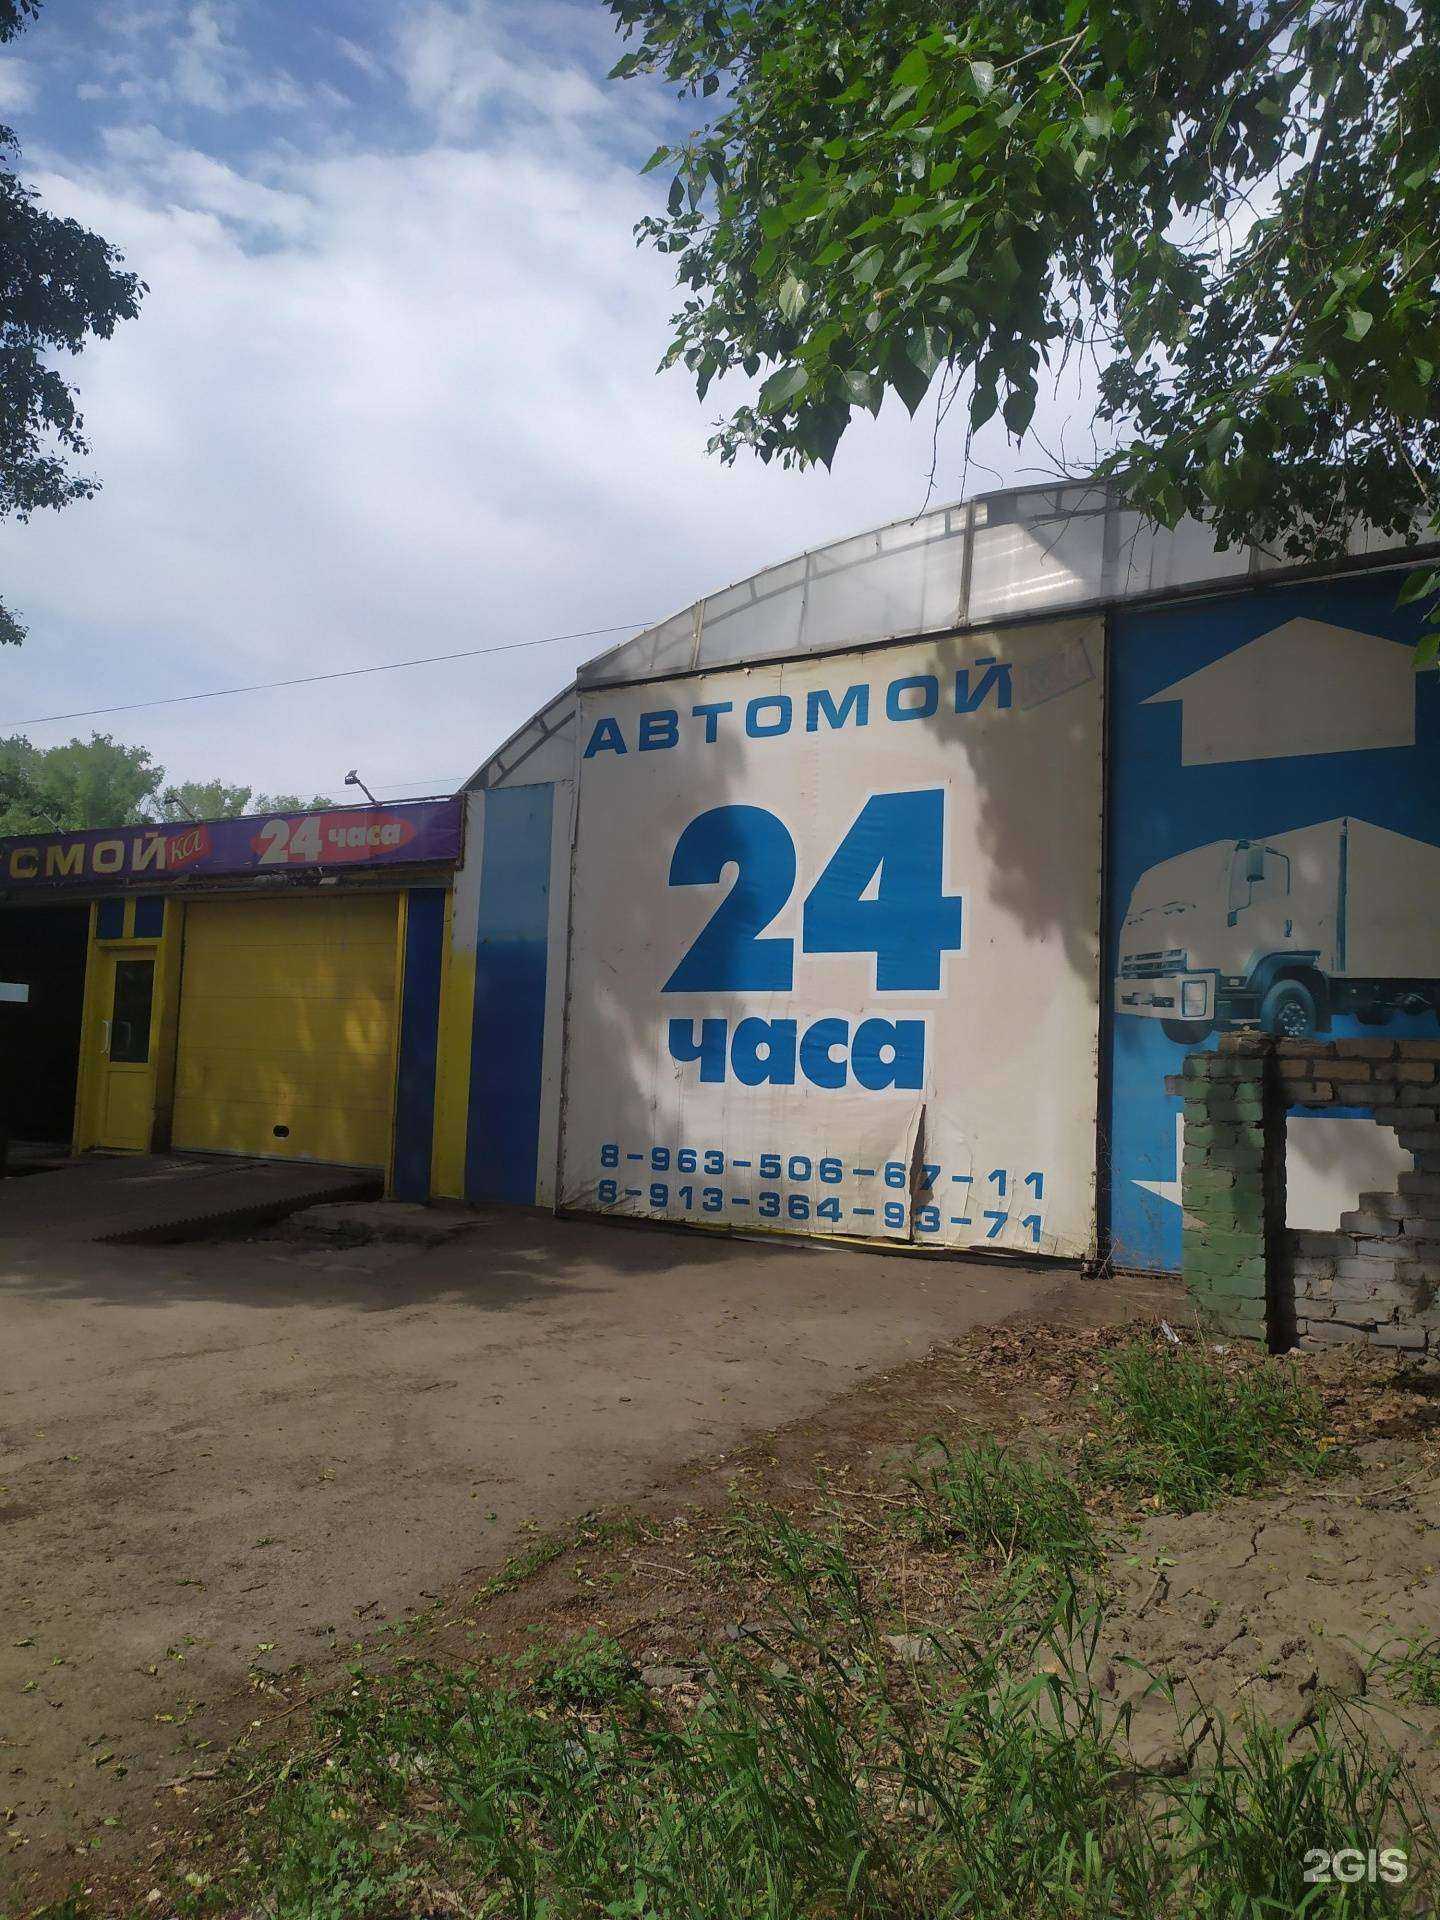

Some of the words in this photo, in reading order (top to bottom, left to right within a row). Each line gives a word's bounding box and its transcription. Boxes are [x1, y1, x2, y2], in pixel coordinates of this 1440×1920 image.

[258, 816, 322, 864] 24
[329, 823, 401, 848] часа
[660, 788, 963, 993] 24
[668, 1017, 926, 1091] часа
[600, 1144, 1045, 1199] 8-963-506-67-11
[598, 1179, 1042, 1243] 8-913-364-93-71
